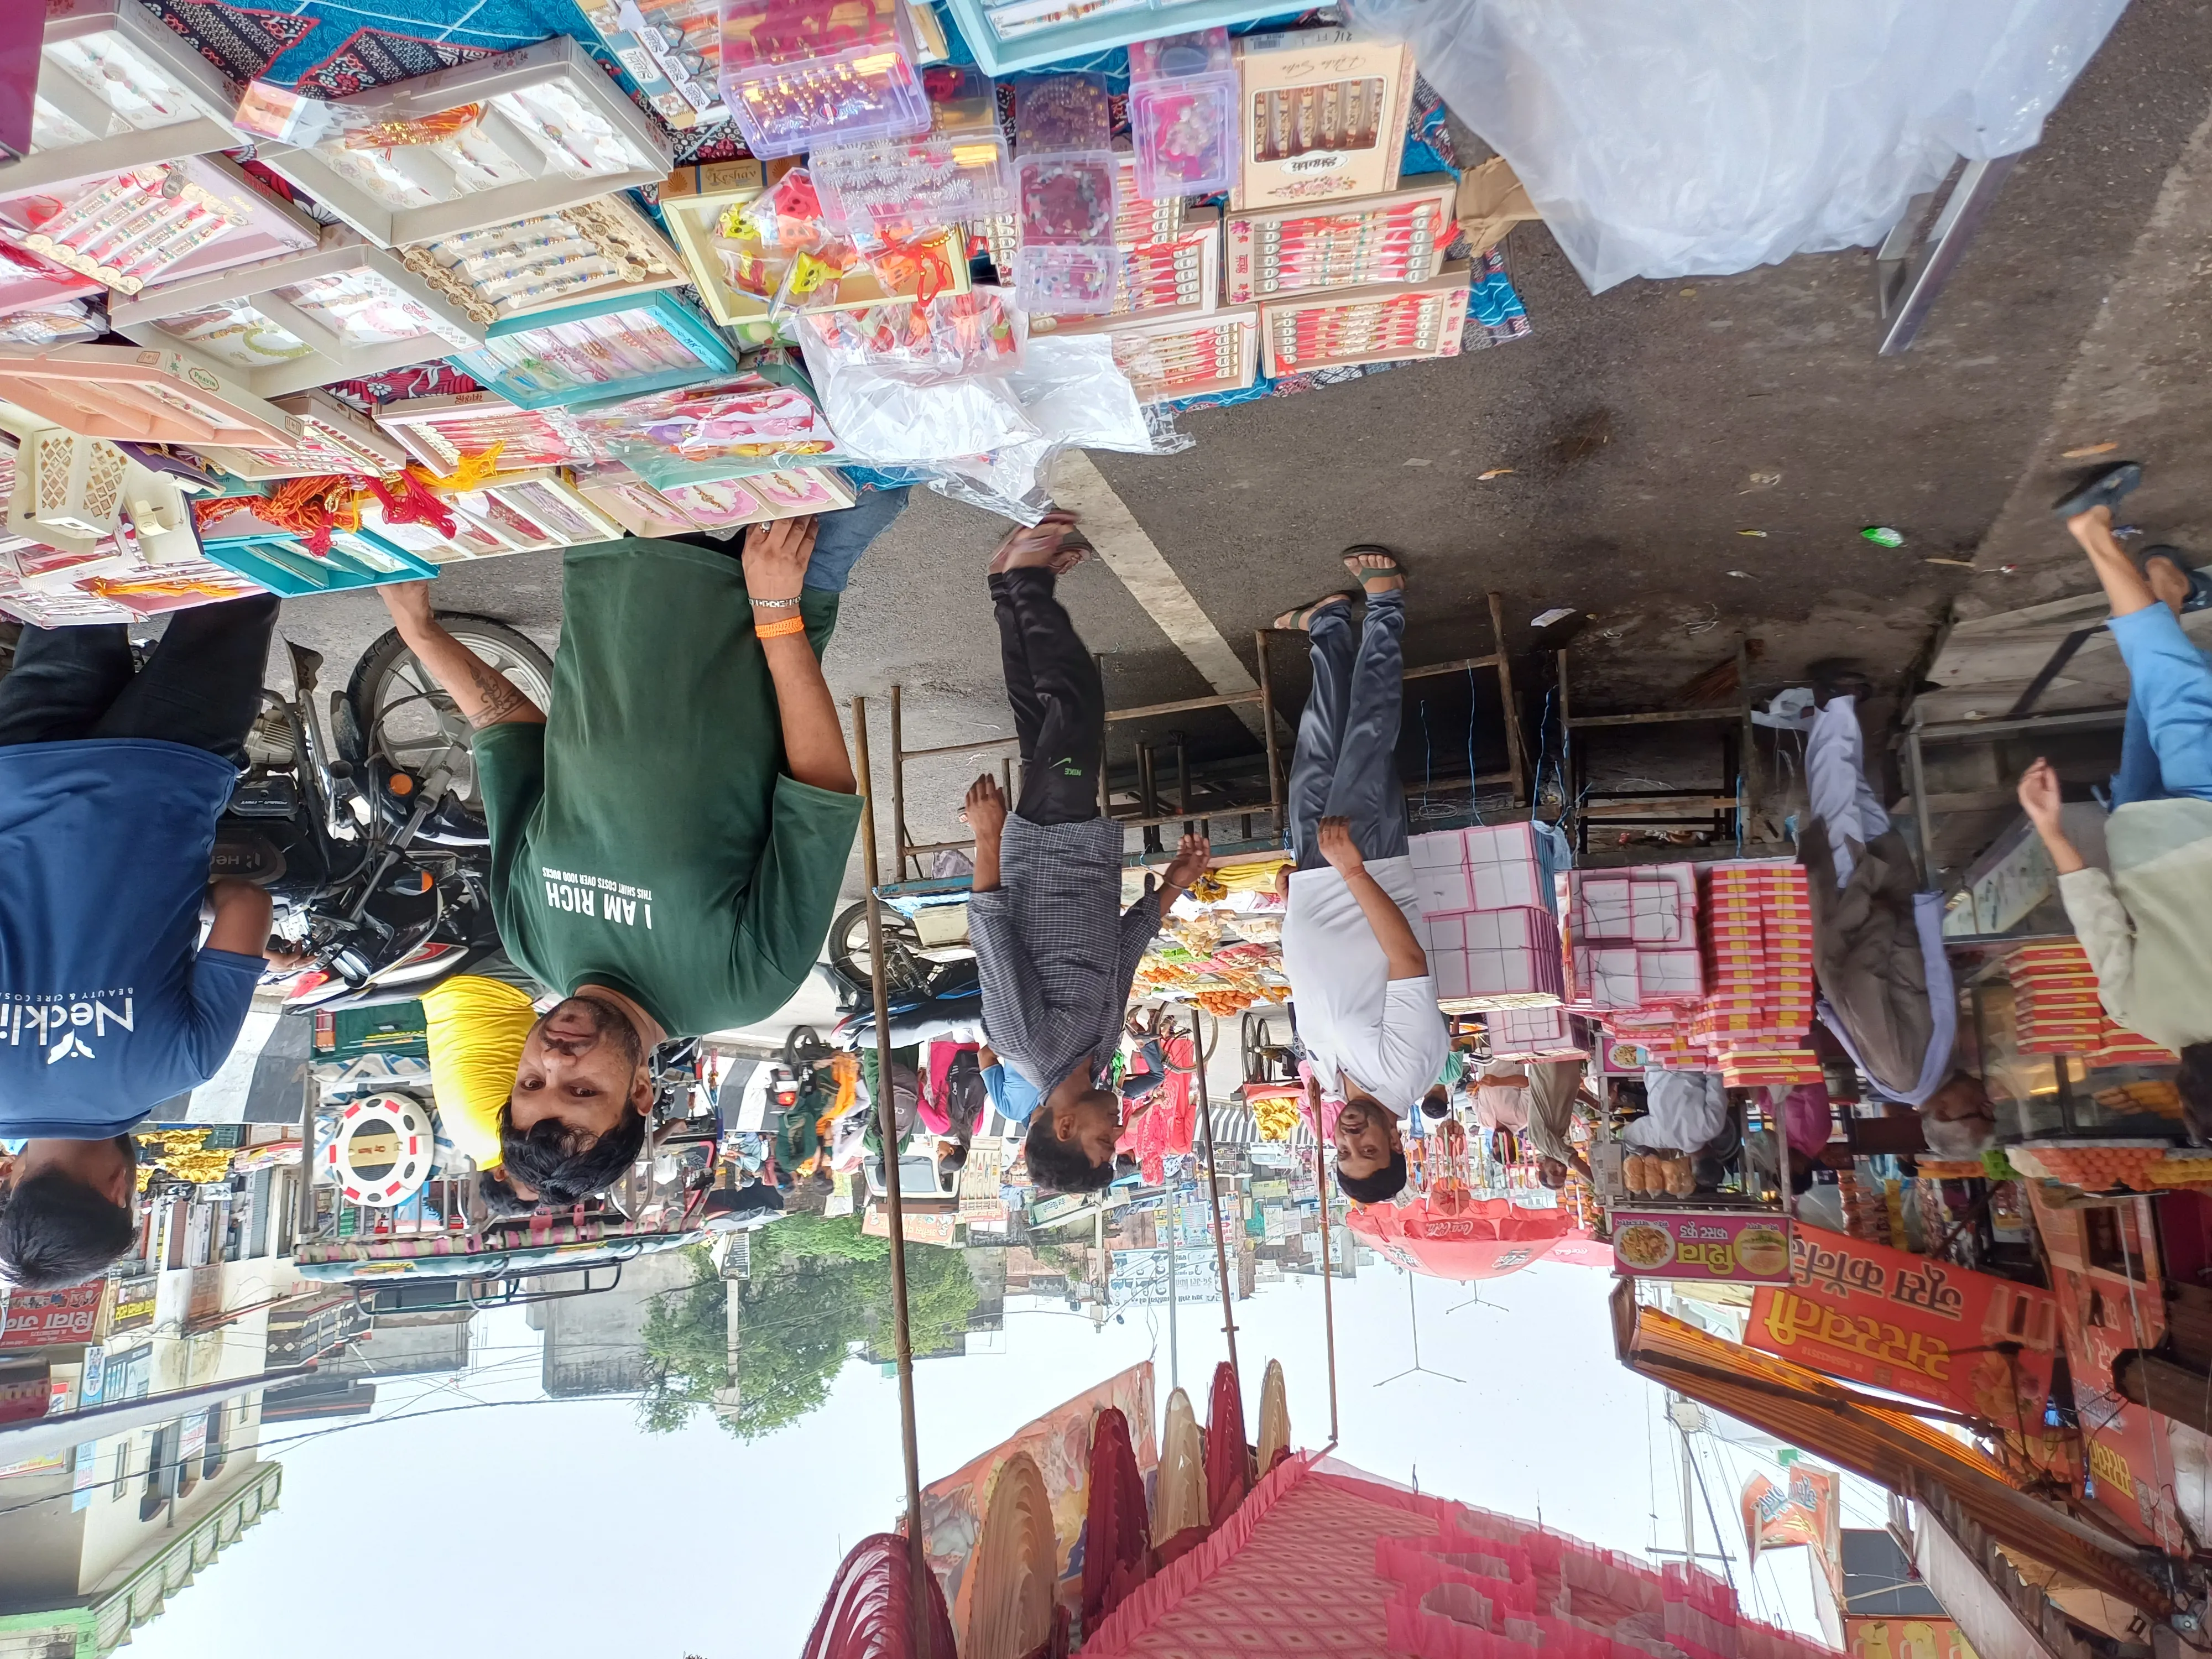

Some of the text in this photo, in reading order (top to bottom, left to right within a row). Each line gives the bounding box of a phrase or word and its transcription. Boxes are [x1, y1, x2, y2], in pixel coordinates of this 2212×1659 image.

[707, 166, 756, 186] Keshav
[1064, 768, 1082, 776] NIKE
[210, 855, 239, 865] Her
[542, 867, 653, 901] THIS SHIRT COSTS OVER 1000 BUCKS
[545, 881, 652, 930] I AM RICH
[0, 993, 30, 1002] COS
[81, 987, 133, 999] BEAUTY
[1426, 1220, 1473, 1237] Coca-Cola
[1679, 1221, 1728, 1240] फास्ट फूड
[1676, 1243, 1735, 1275] शिव
[1890, 1263, 1963, 1321] जूस
[1765, 1290, 1949, 1381] सरस्वती
